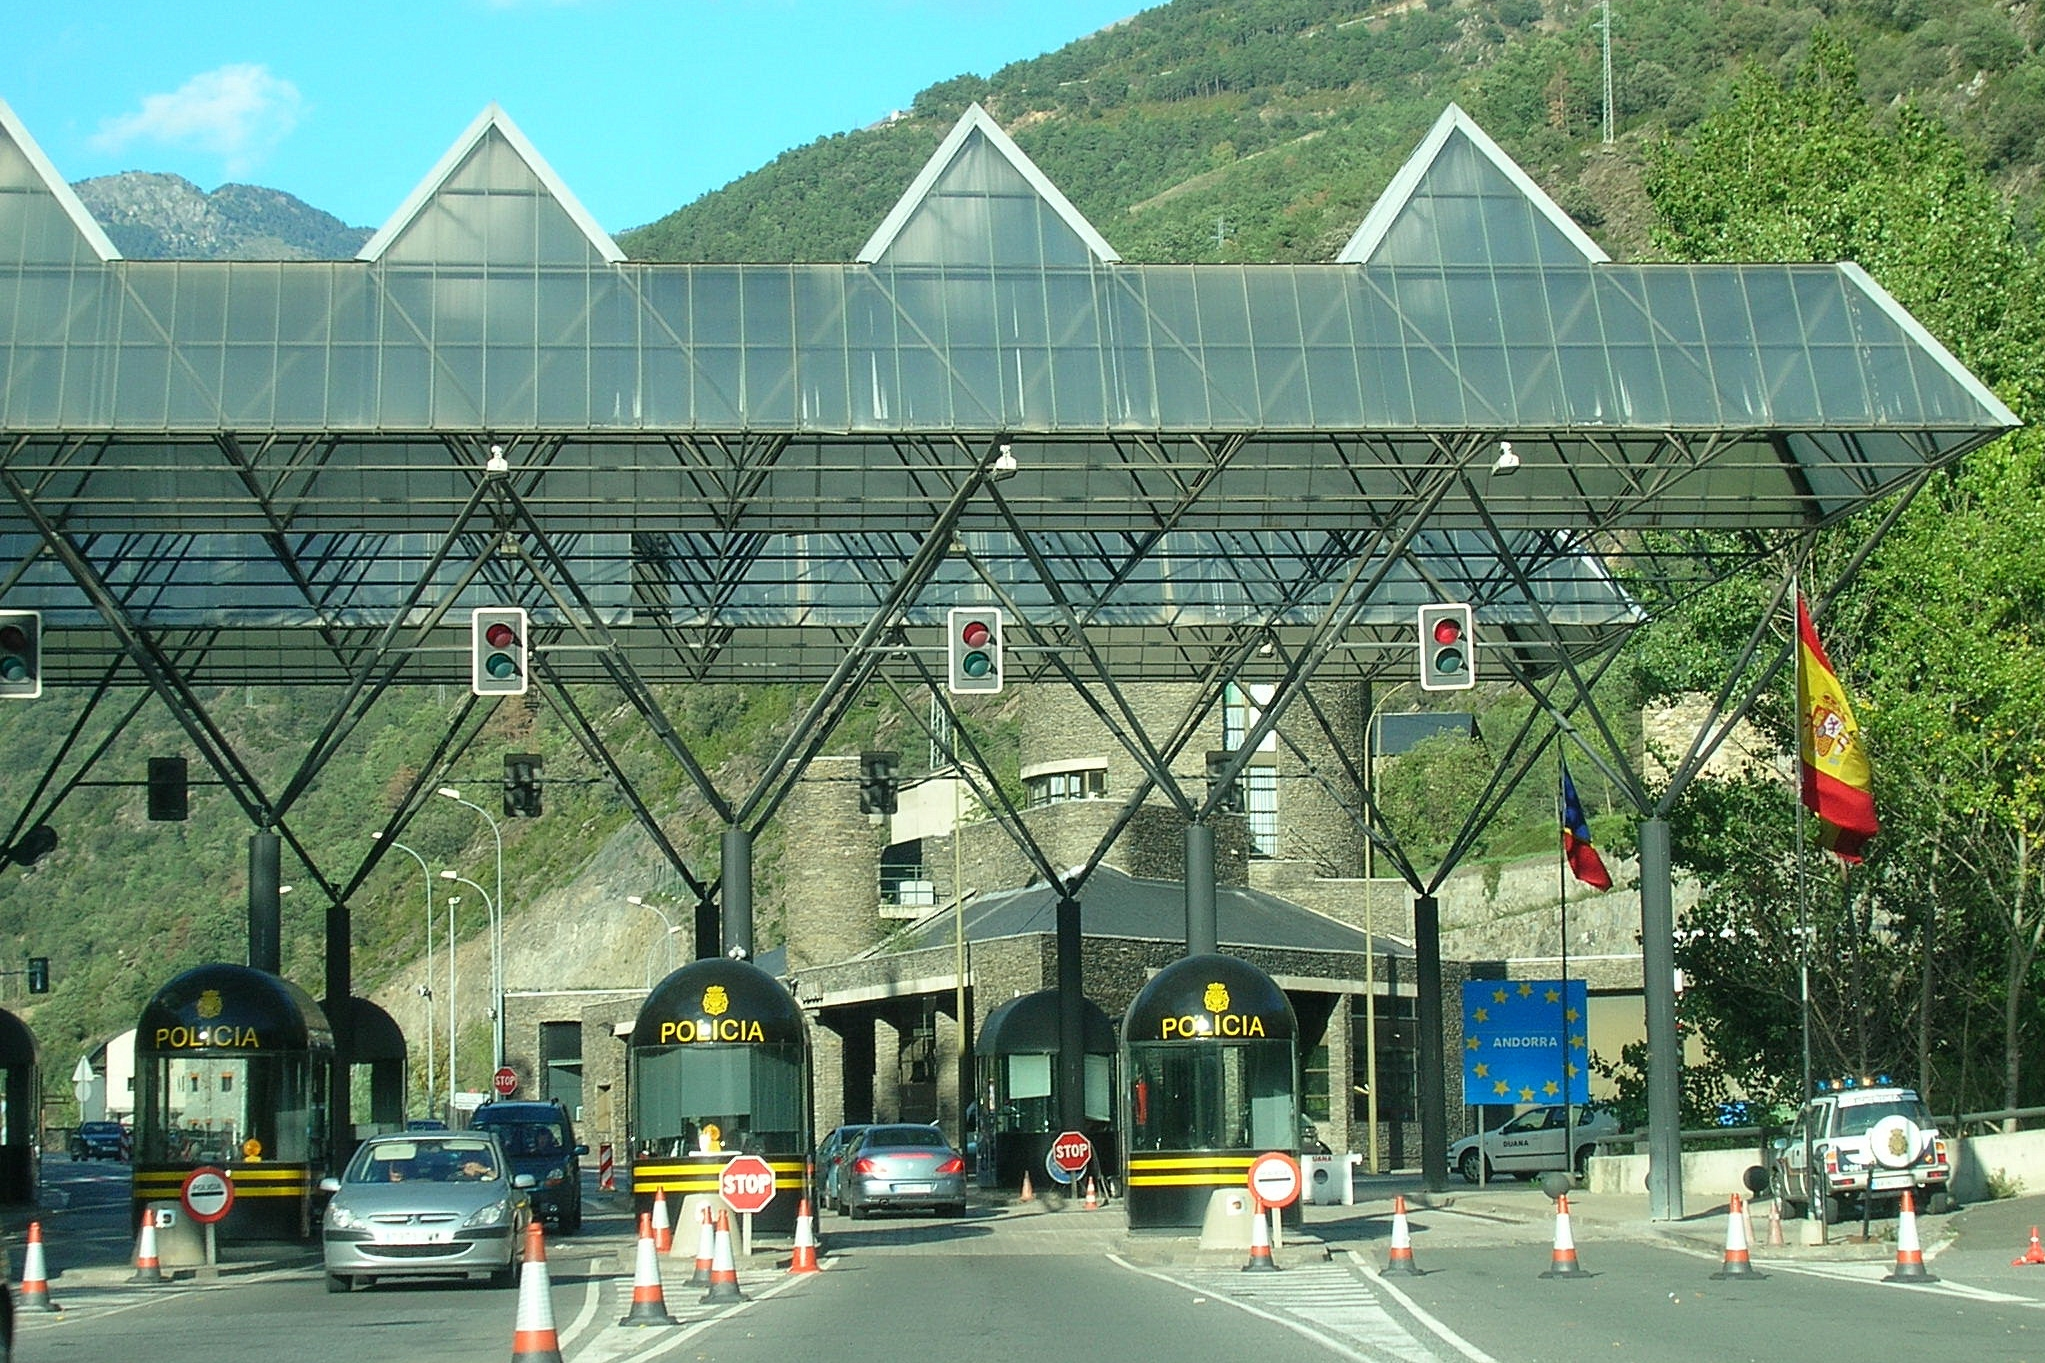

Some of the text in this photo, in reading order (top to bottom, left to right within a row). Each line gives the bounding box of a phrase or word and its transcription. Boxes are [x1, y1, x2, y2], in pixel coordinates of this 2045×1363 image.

[156, 1025, 259, 1048] POLICIA
[661, 1019, 765, 1043] POLICIA
[1162, 1015, 1265, 1039] POLICIA
[1493, 1036, 1558, 1048] ANDORRA
[495, 1076, 516, 1086] STOP
[1056, 1143, 1088, 1159] STOP
[723, 1174, 771, 1194] STOP
